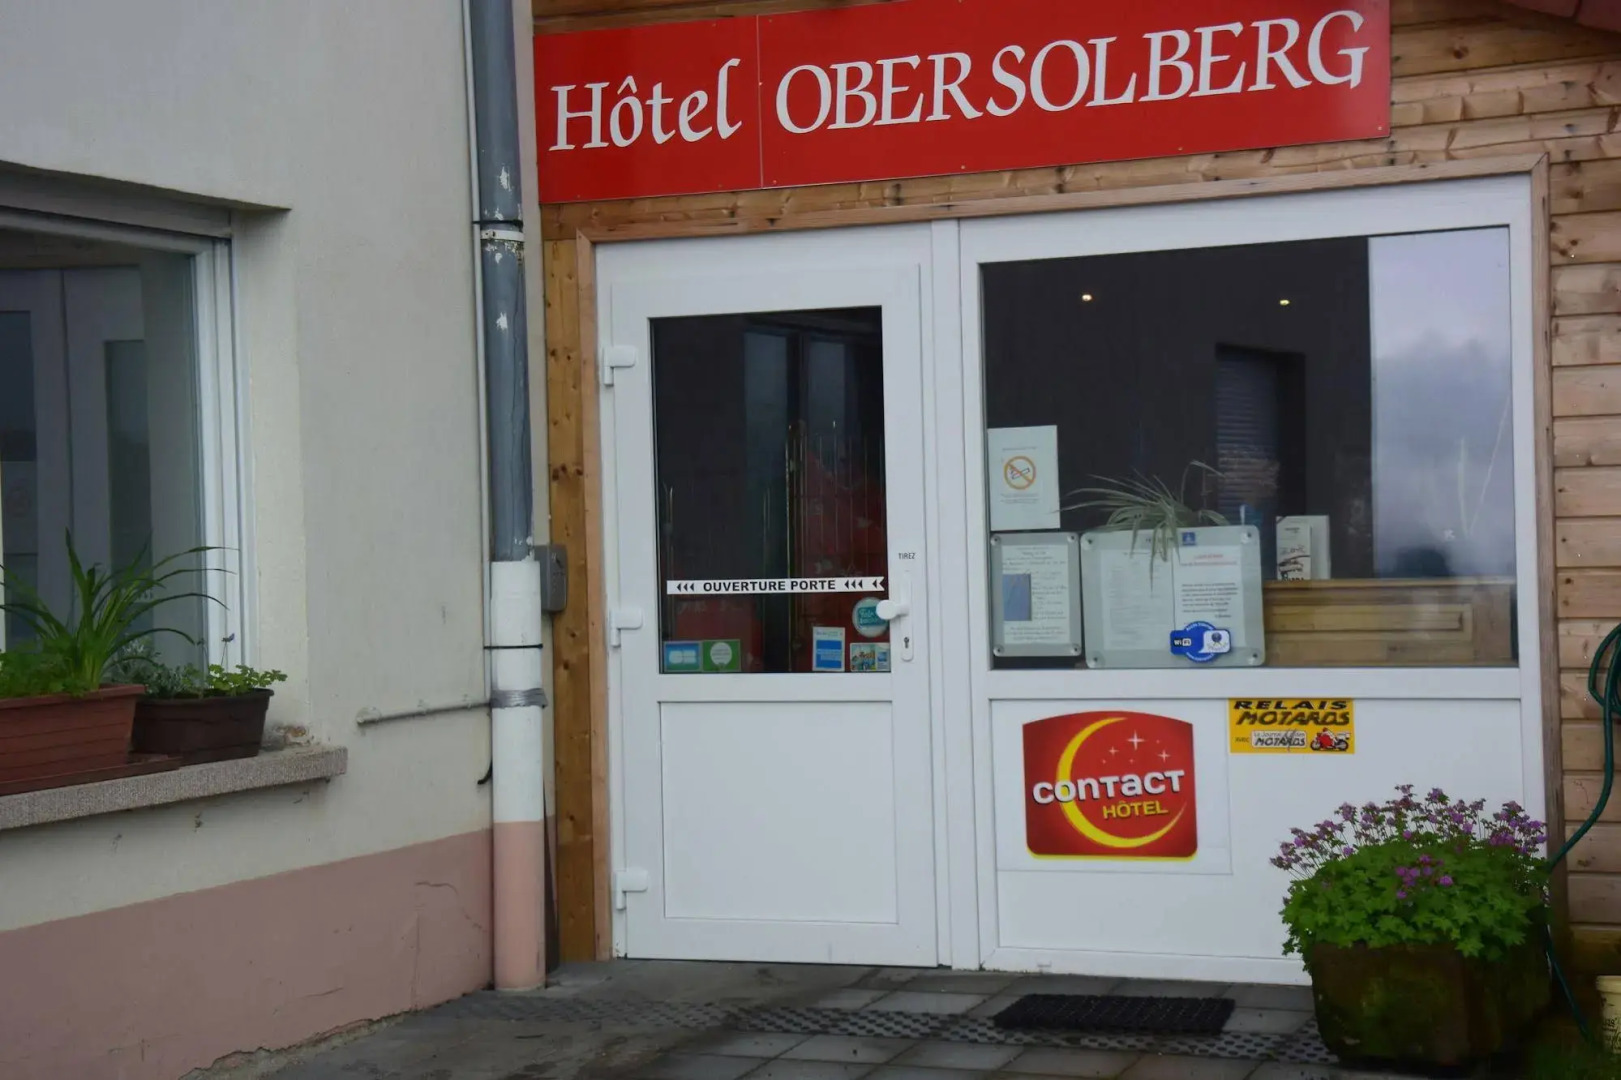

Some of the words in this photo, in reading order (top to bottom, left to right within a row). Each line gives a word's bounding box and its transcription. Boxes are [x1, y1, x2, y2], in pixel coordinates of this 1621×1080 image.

[549, 58, 743, 151] Hôtel
[775, 10, 1370, 134] OBERSOLBERG
[898, 552, 916, 560] TIREZ
[703, 580, 786, 592] OUVERTURE
[790, 579, 836, 591] PORTE
[1234, 700, 1349, 710] RELAIS
[1235, 711, 1350, 726] MOTARDS
[1102, 800, 1169, 819] HÔTEL
